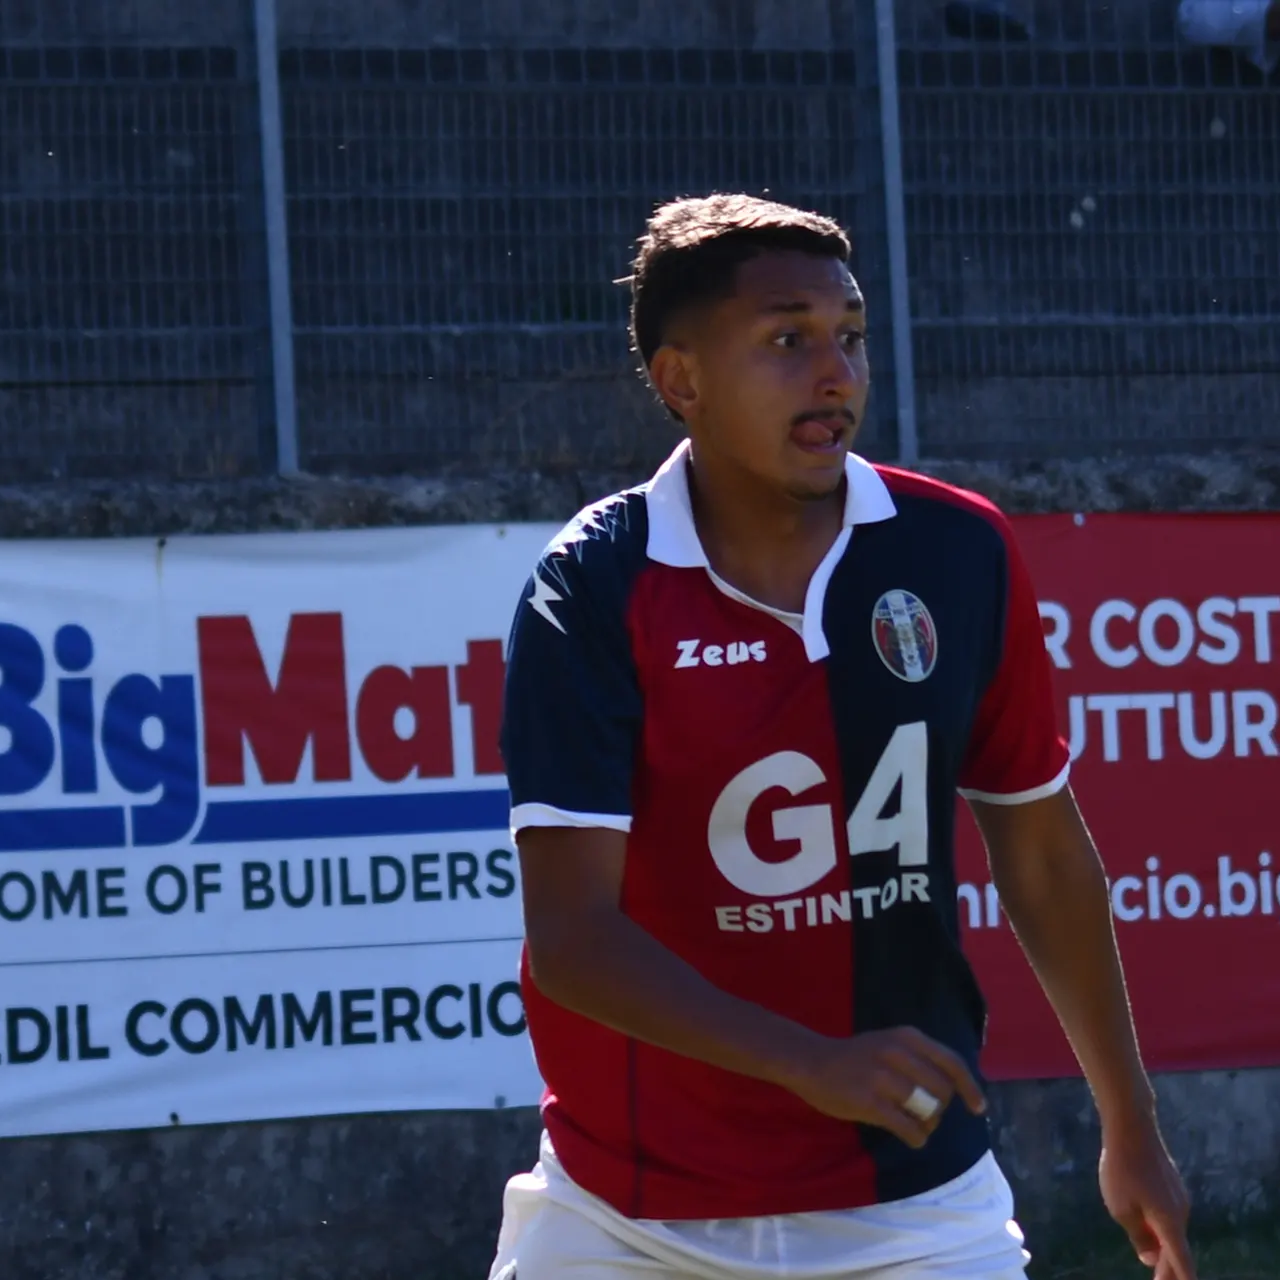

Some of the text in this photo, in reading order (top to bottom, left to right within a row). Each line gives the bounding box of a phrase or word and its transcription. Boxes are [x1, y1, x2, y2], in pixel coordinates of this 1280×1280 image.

[675, 638, 767, 669] Zeus
[708, 720, 929, 896] G4
[145, 864, 223, 916] OF
[242, 848, 516, 911] BUILDERS
[716, 872, 931, 933] ESTINTOR
[124, 980, 528, 1057] COMMERCIO
